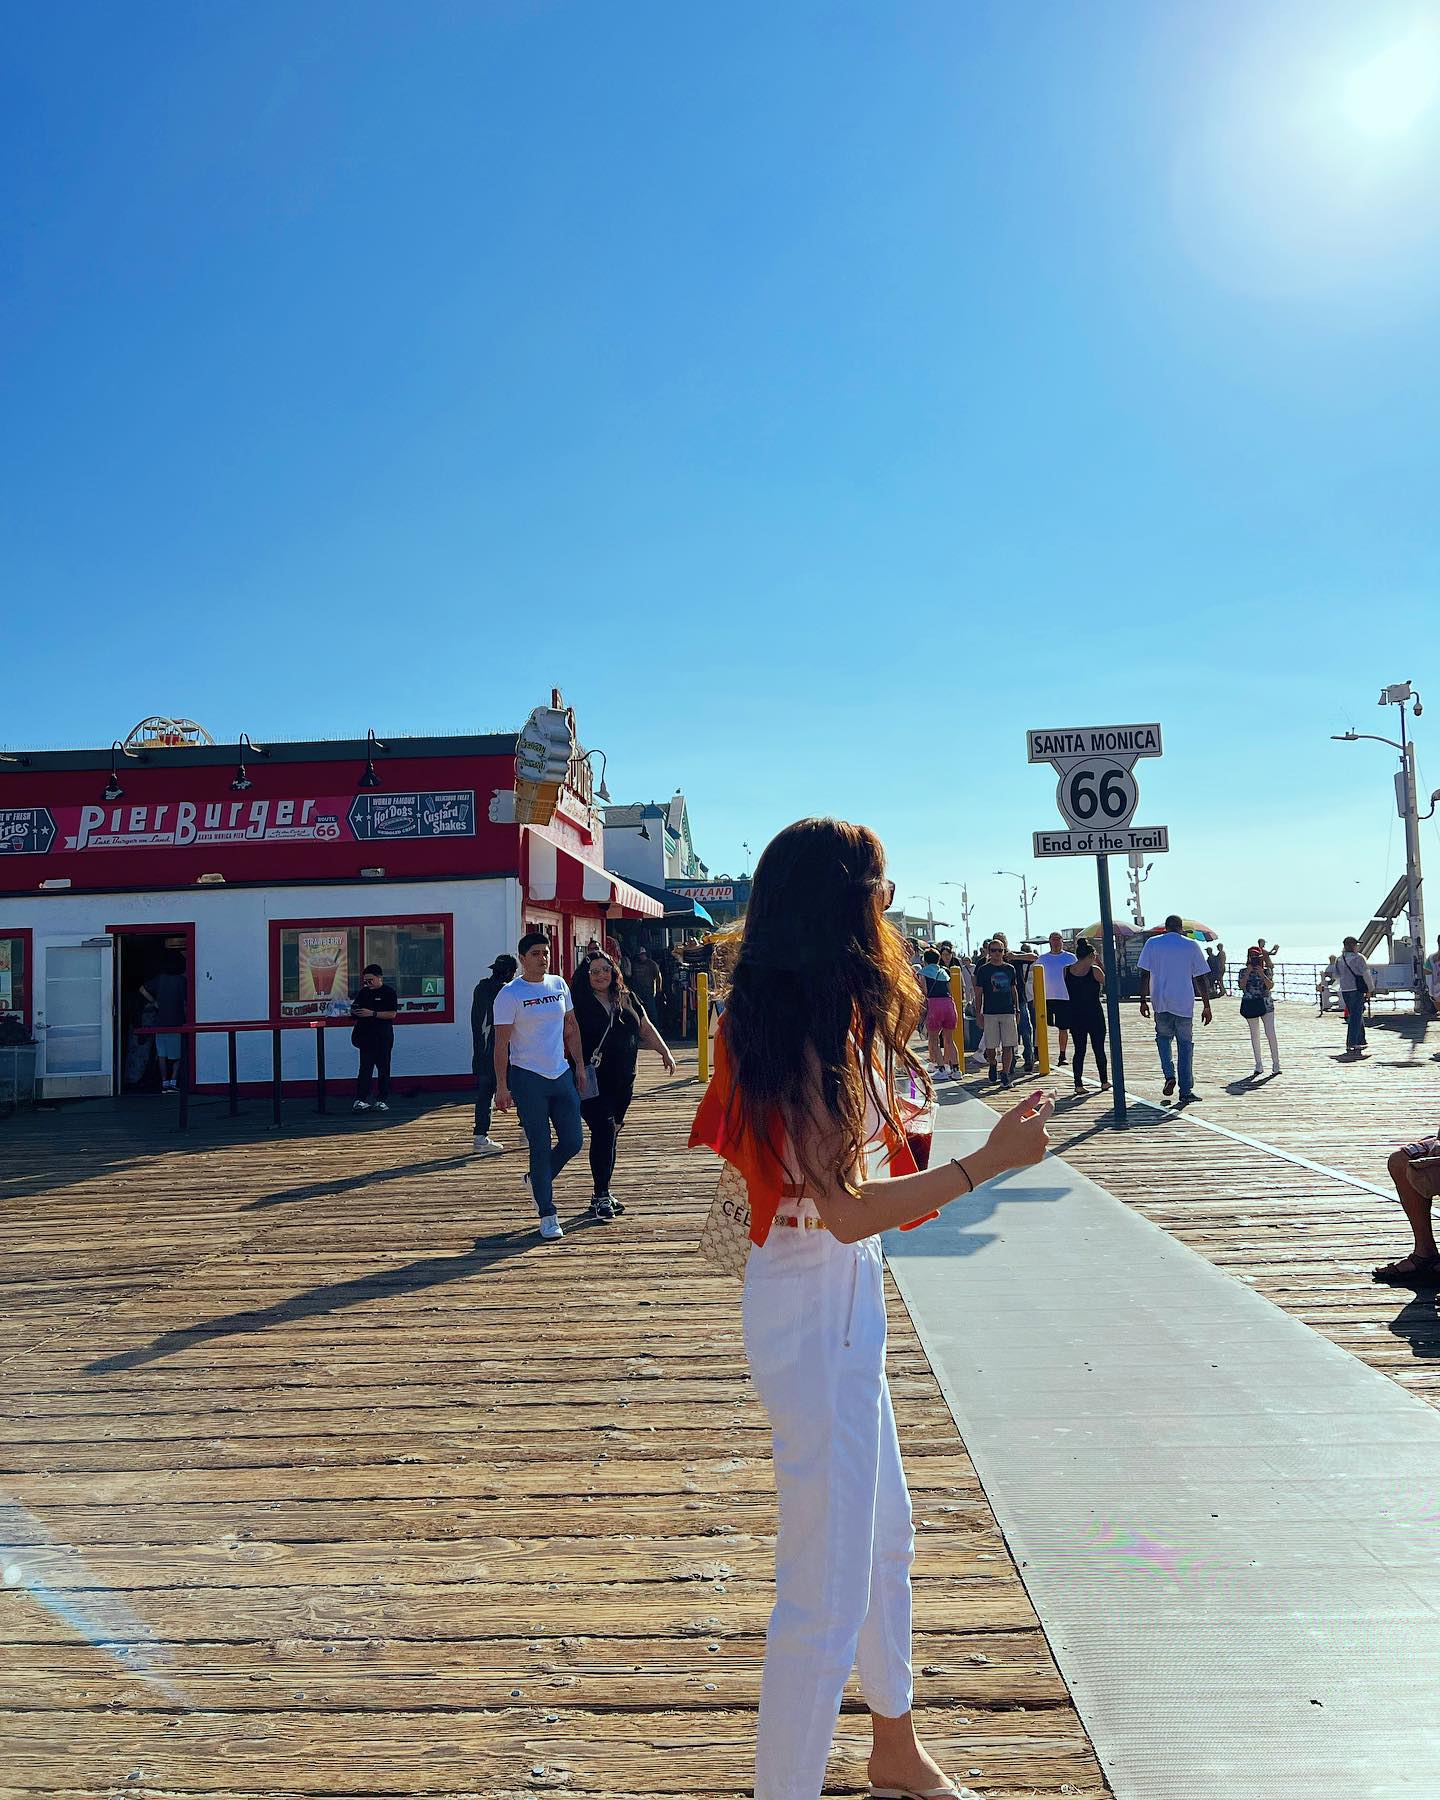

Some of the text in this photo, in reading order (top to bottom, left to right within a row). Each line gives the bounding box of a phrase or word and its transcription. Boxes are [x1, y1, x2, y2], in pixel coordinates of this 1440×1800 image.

[1034, 730, 1156, 754] SANTA MONICA
[1070, 769, 1127, 819] 66
[423, 805, 458, 825] Custard
[316, 825, 336, 837] 66
[432, 819, 467, 834] Shakes
[1042, 830, 1162, 851] End of the Trail
[303, 936, 343, 946] STRAWBERRY
[424, 982, 434, 993] A
[722, 1200, 751, 1227] CEL
